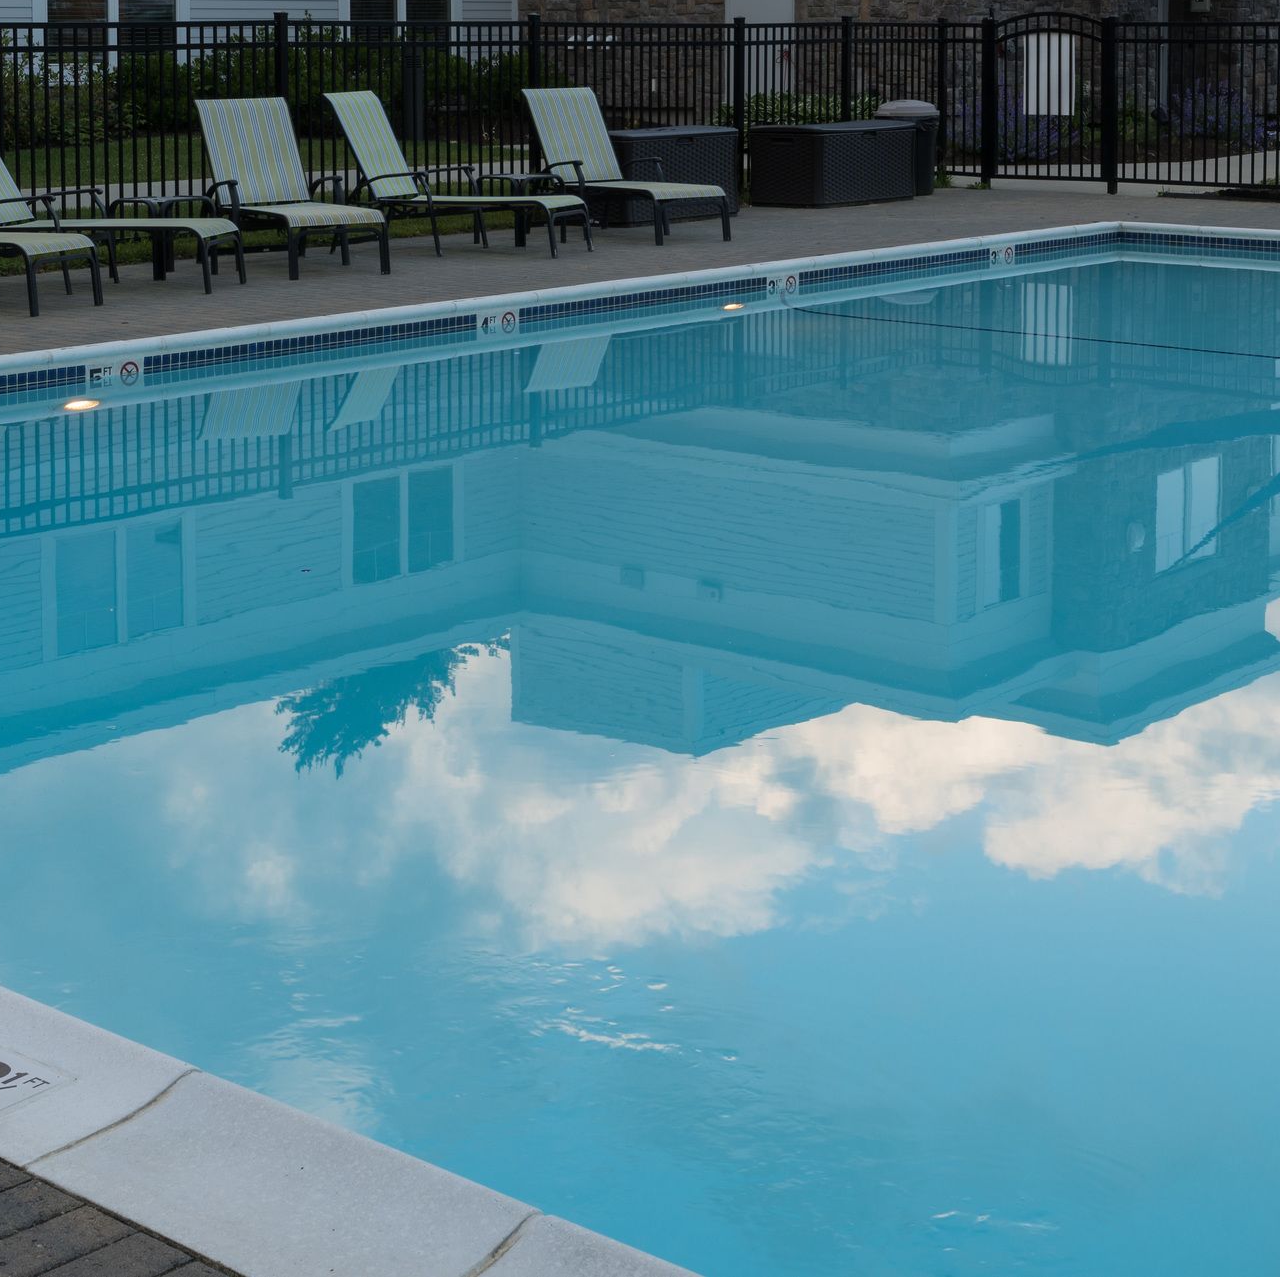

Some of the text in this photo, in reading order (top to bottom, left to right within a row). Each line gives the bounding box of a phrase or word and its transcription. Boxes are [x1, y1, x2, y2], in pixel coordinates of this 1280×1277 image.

[489, 315, 497, 324] FT
[103, 366, 113, 376] FT
[23, 1076, 51, 1089] FT
